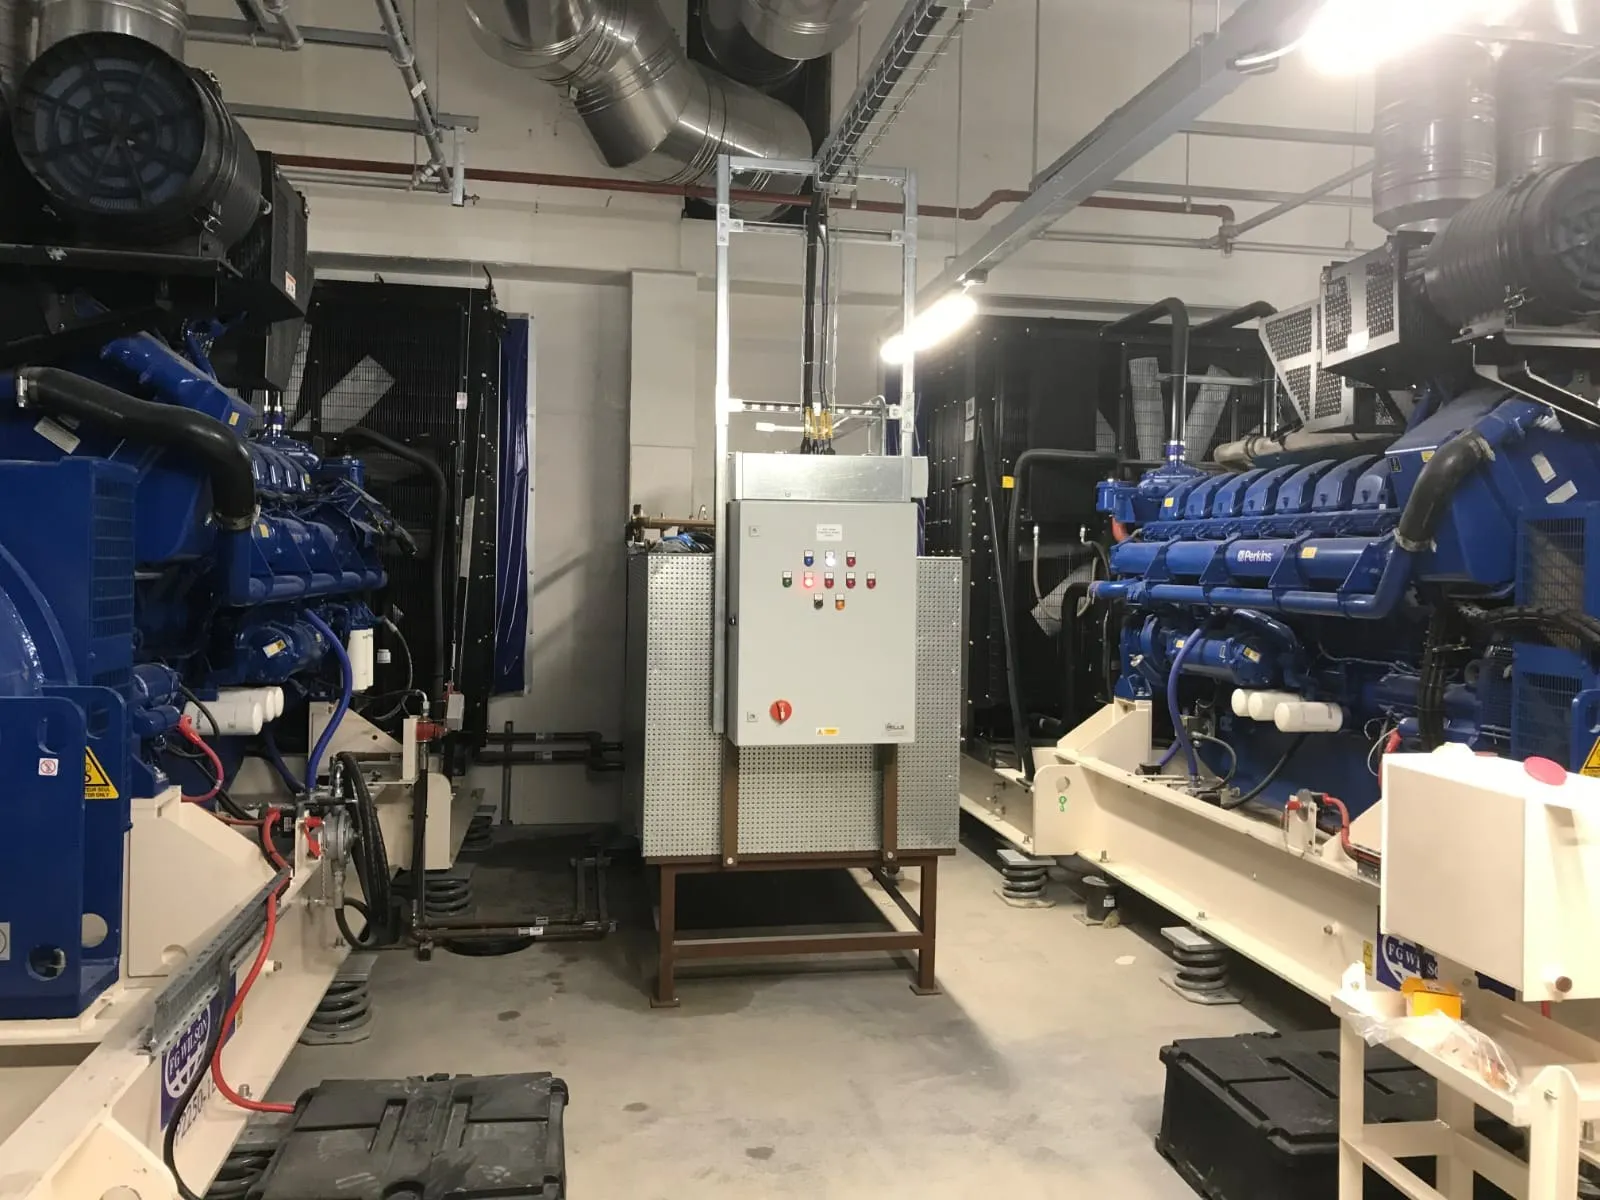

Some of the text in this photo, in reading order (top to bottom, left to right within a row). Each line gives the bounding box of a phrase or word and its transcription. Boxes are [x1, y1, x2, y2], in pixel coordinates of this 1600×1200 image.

[1245, 550, 1272, 562] Perkins
[1388, 943, 1404, 960] FG
[180, 1018, 209, 1061] WILSON
